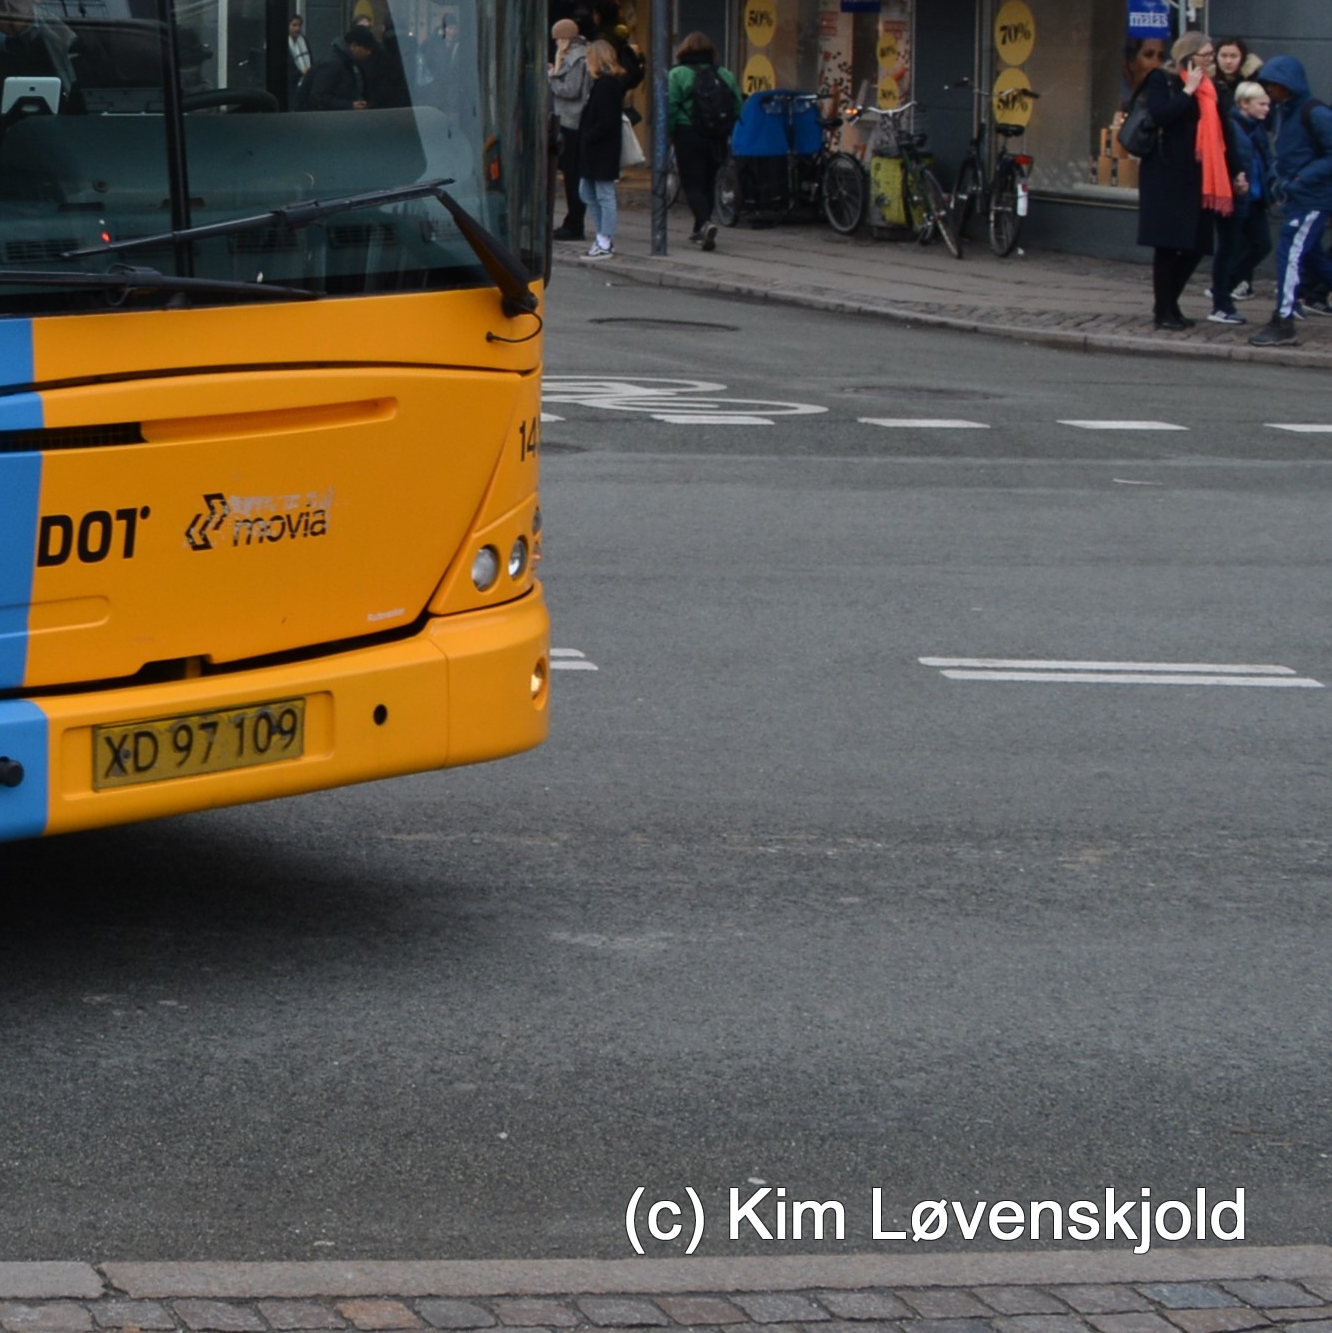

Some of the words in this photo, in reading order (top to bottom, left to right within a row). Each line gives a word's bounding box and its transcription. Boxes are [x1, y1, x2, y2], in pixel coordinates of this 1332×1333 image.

[999, 21, 1032, 45] 70%
[1129, 12, 1168, 27] matas
[36, 505, 150, 567] DOT
[232, 508, 327, 546] movia
[104, 730, 160, 779] XD
[173, 721, 219, 767] 97
[235, 707, 298, 759] 109
